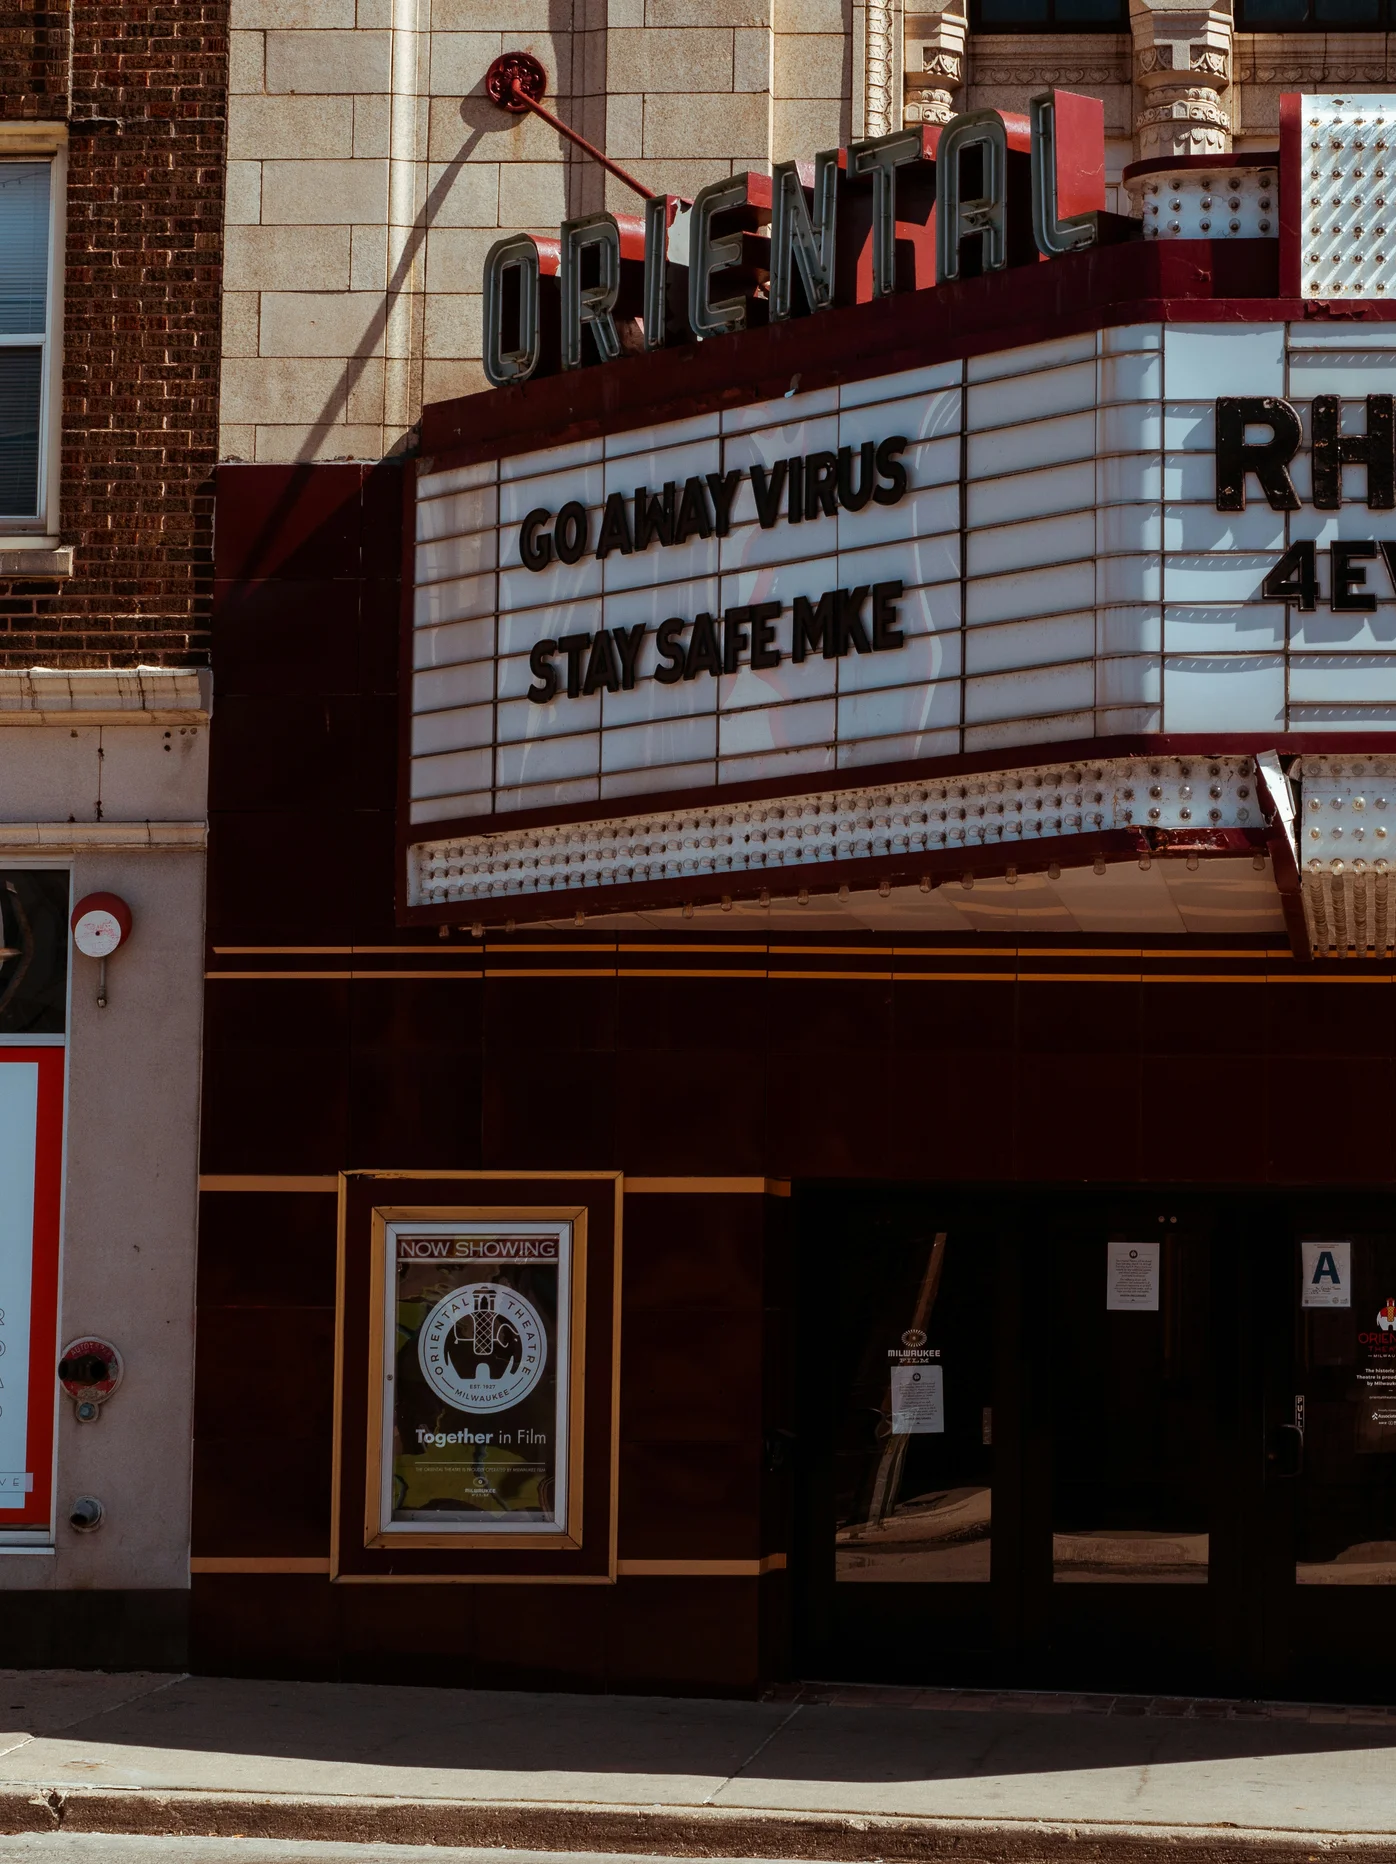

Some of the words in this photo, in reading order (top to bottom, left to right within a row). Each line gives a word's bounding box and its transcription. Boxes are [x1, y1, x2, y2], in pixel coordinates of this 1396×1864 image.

[483, 89, 1104, 387] ORIENTAL
[518, 500, 589, 572] GO
[595, 468, 743, 560] AWAY
[749, 436, 909, 529] VIRUS
[527, 621, 647, 703] STAY
[653, 600, 781, 685] SAFE
[791, 579, 905, 665] MKE
[400, 1241, 451, 1257] NOW
[455, 1241, 556, 1257] SHOWING
[1311, 1251, 1341, 1284] A
[429, 1298, 470, 1376] ORIENTAL
[507, 1301, 537, 1376] THEATRE
[887, 1349, 941, 1357] MILWAUKEE
[454, 1388, 510, 1402] MILWAUKEE
[415, 1427, 494, 1448] Together
[499, 1430, 512, 1444] in
[517, 1428, 547, 1444] Film
